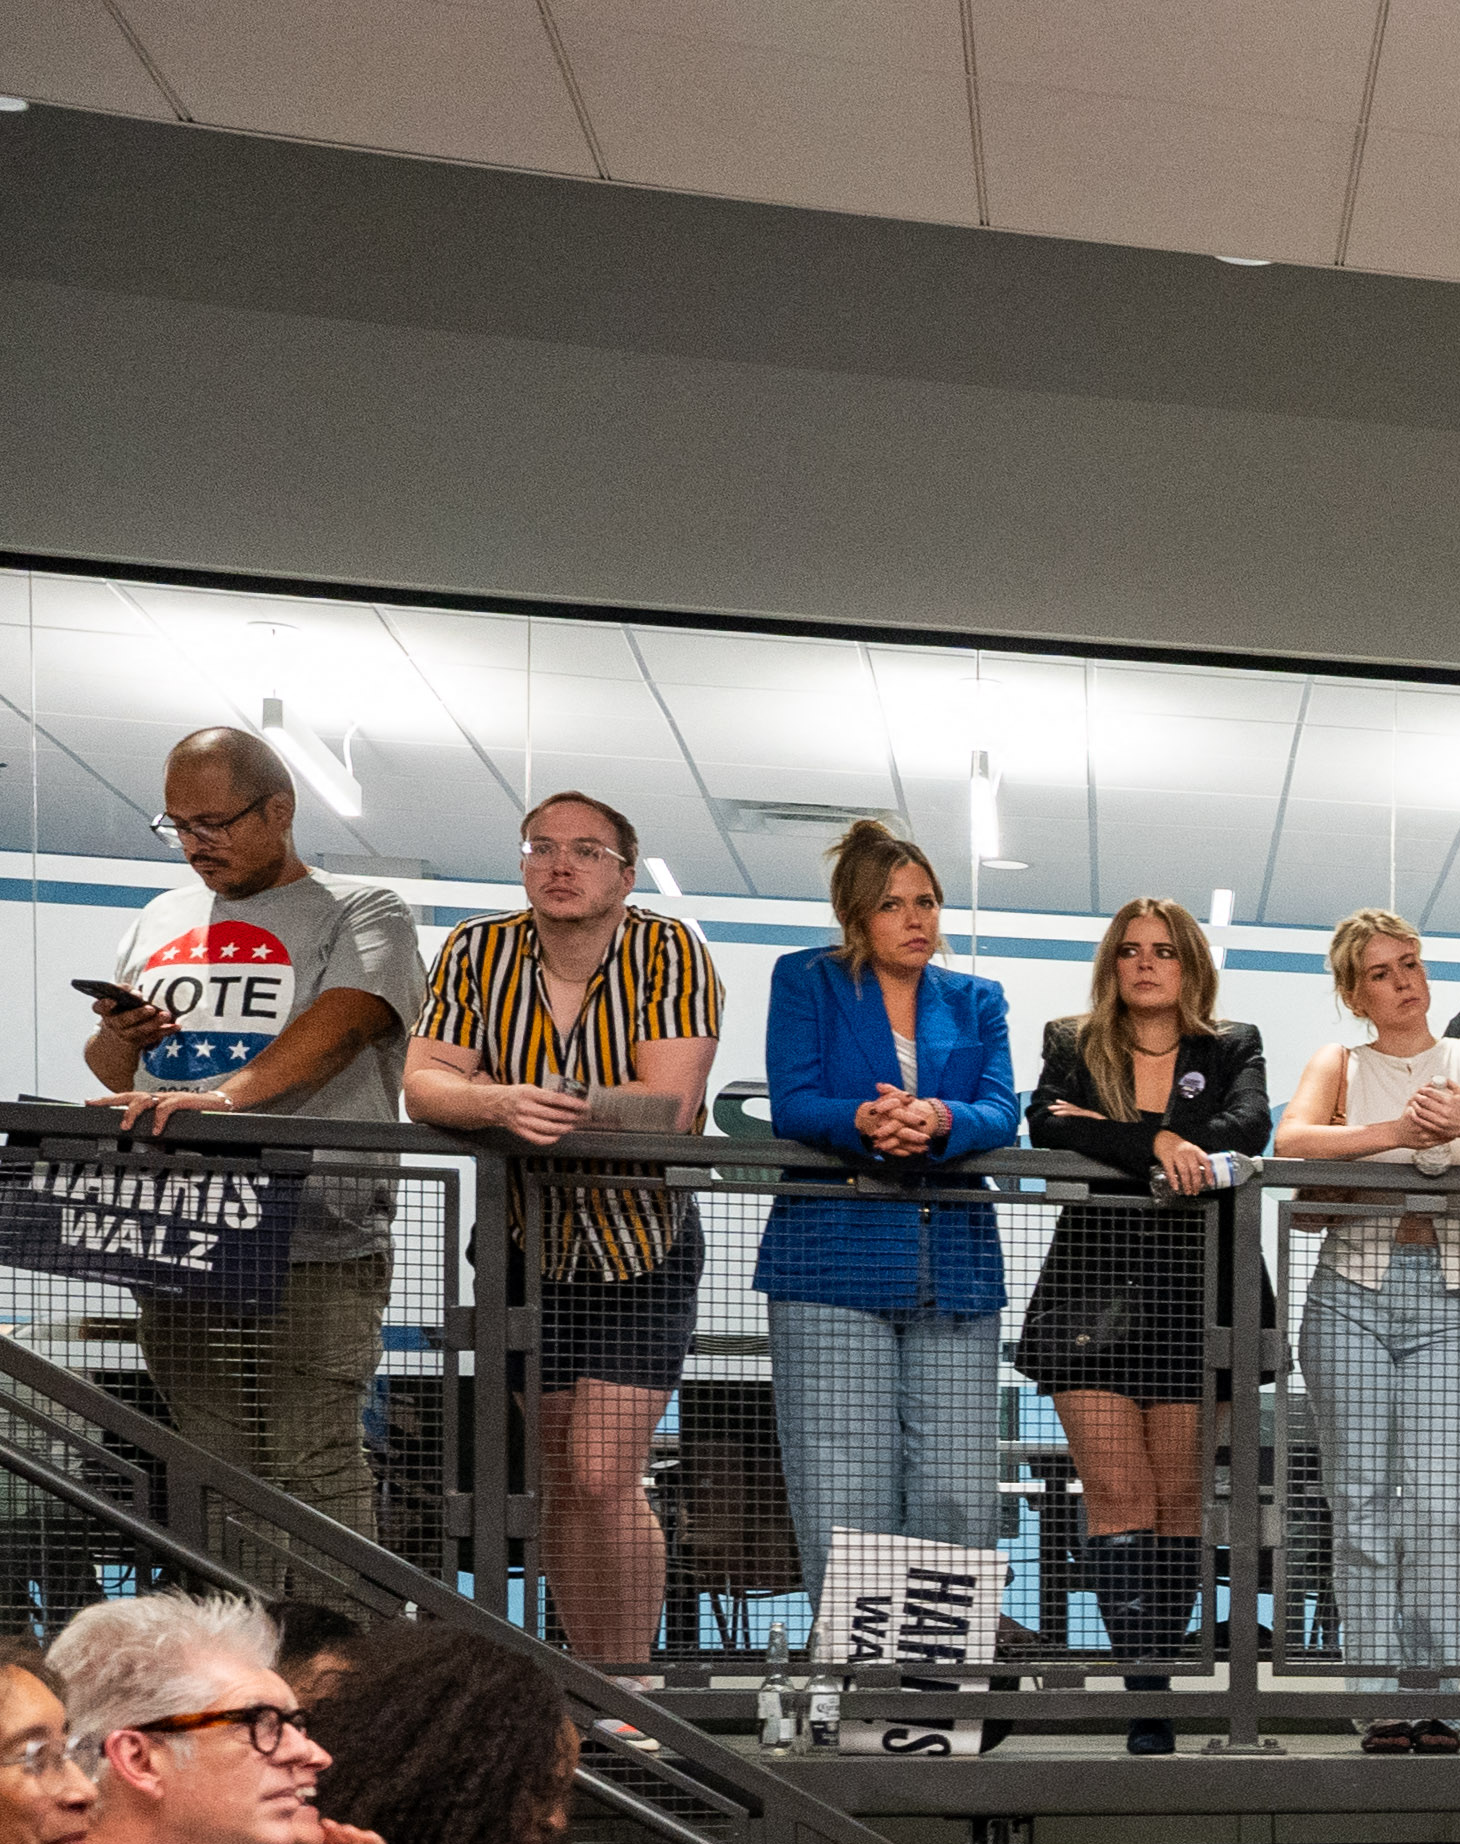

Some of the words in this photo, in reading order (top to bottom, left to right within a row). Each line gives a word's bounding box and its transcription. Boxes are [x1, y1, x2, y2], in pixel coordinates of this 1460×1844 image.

[138, 976, 282, 1020] VOTE
[60, 1207, 220, 1272] WALZ
[882, 1567, 976, 1756] HARS
